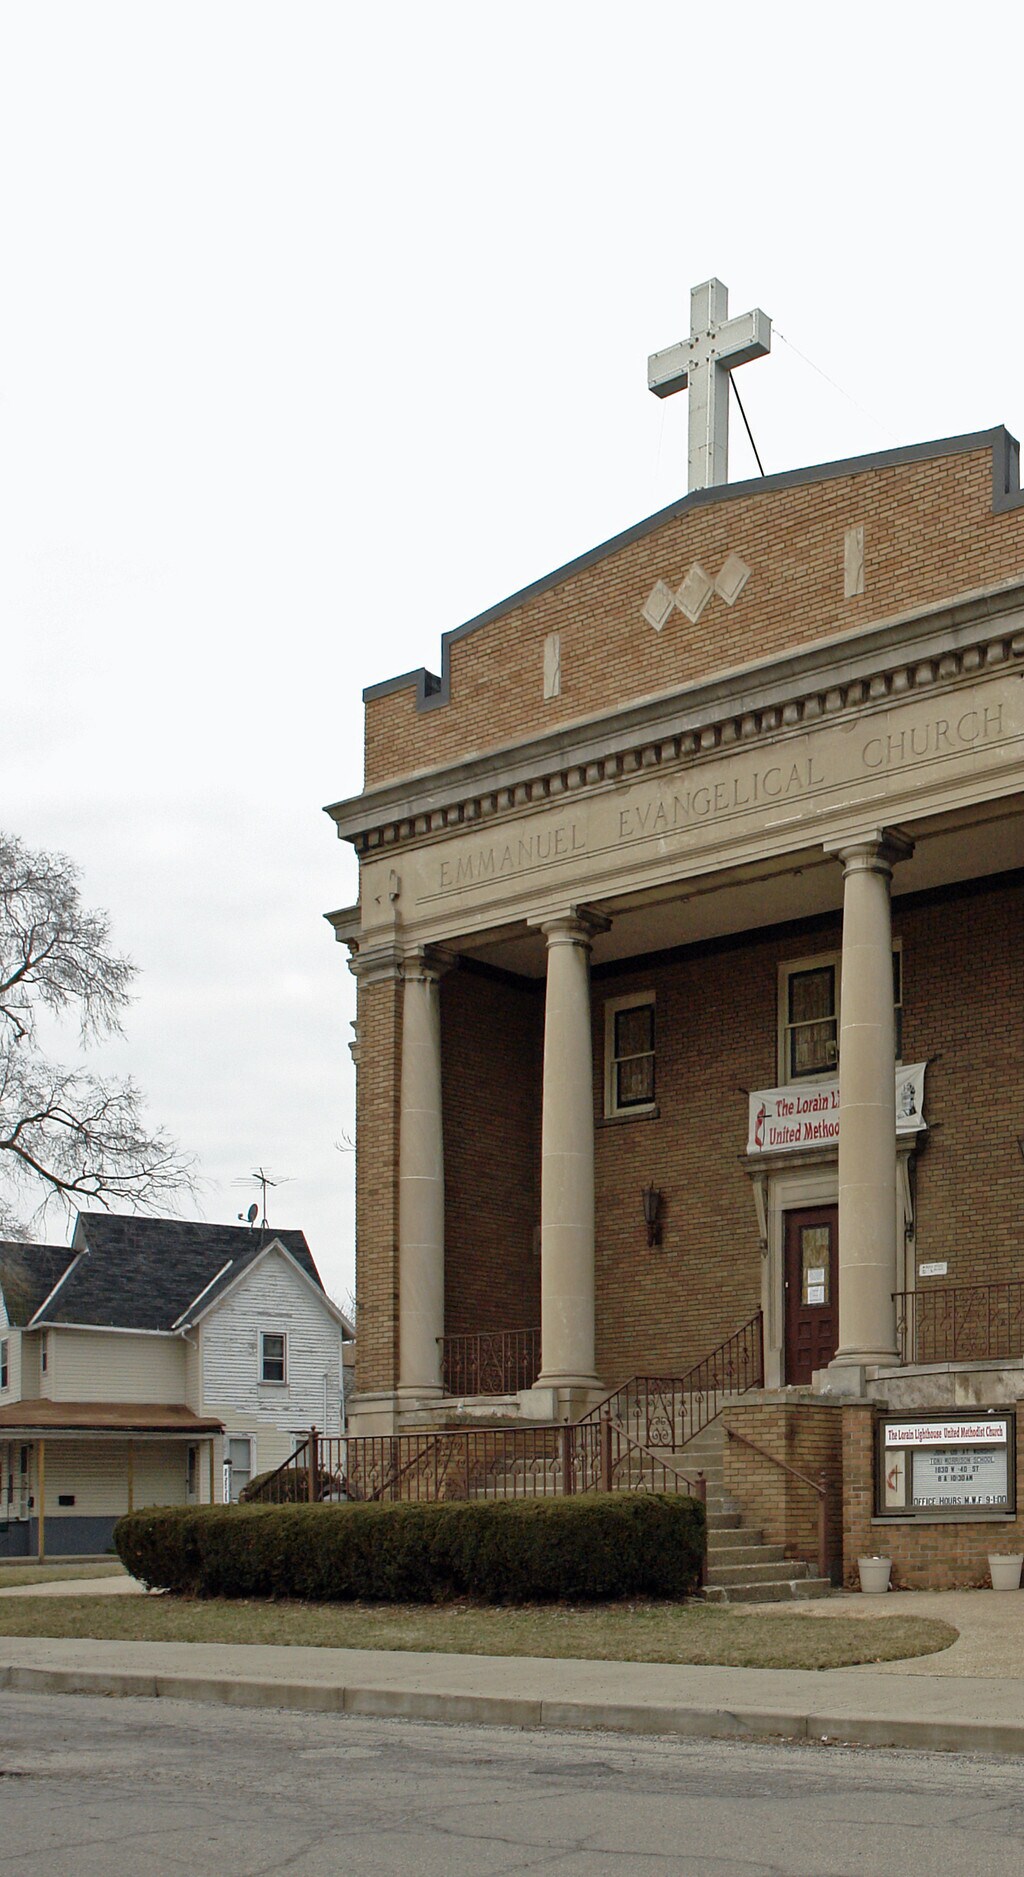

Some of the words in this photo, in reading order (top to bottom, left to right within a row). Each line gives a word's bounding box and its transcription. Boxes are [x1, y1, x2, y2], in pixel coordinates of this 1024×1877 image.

[439, 824, 586, 888] EMMANUEL
[619, 757, 824, 837] EVANGELICAL
[862, 703, 1005, 768] CHURCH
[776, 1098, 793, 1117] The
[796, 1090, 829, 1114] Lorain
[769, 1124, 801, 1145] United
[888, 1430, 897, 1440] The
[898, 1429, 914, 1440] Lorain
[915, 1428, 942, 1442] Lighthouse
[944, 1427, 960, 1438] United
[961, 1426, 985, 1438] Methodist
[986, 1425, 1003, 1437] Church
[914, 1497, 936, 1505] OFFICE
[939, 1496, 961, 1504] HOURS
